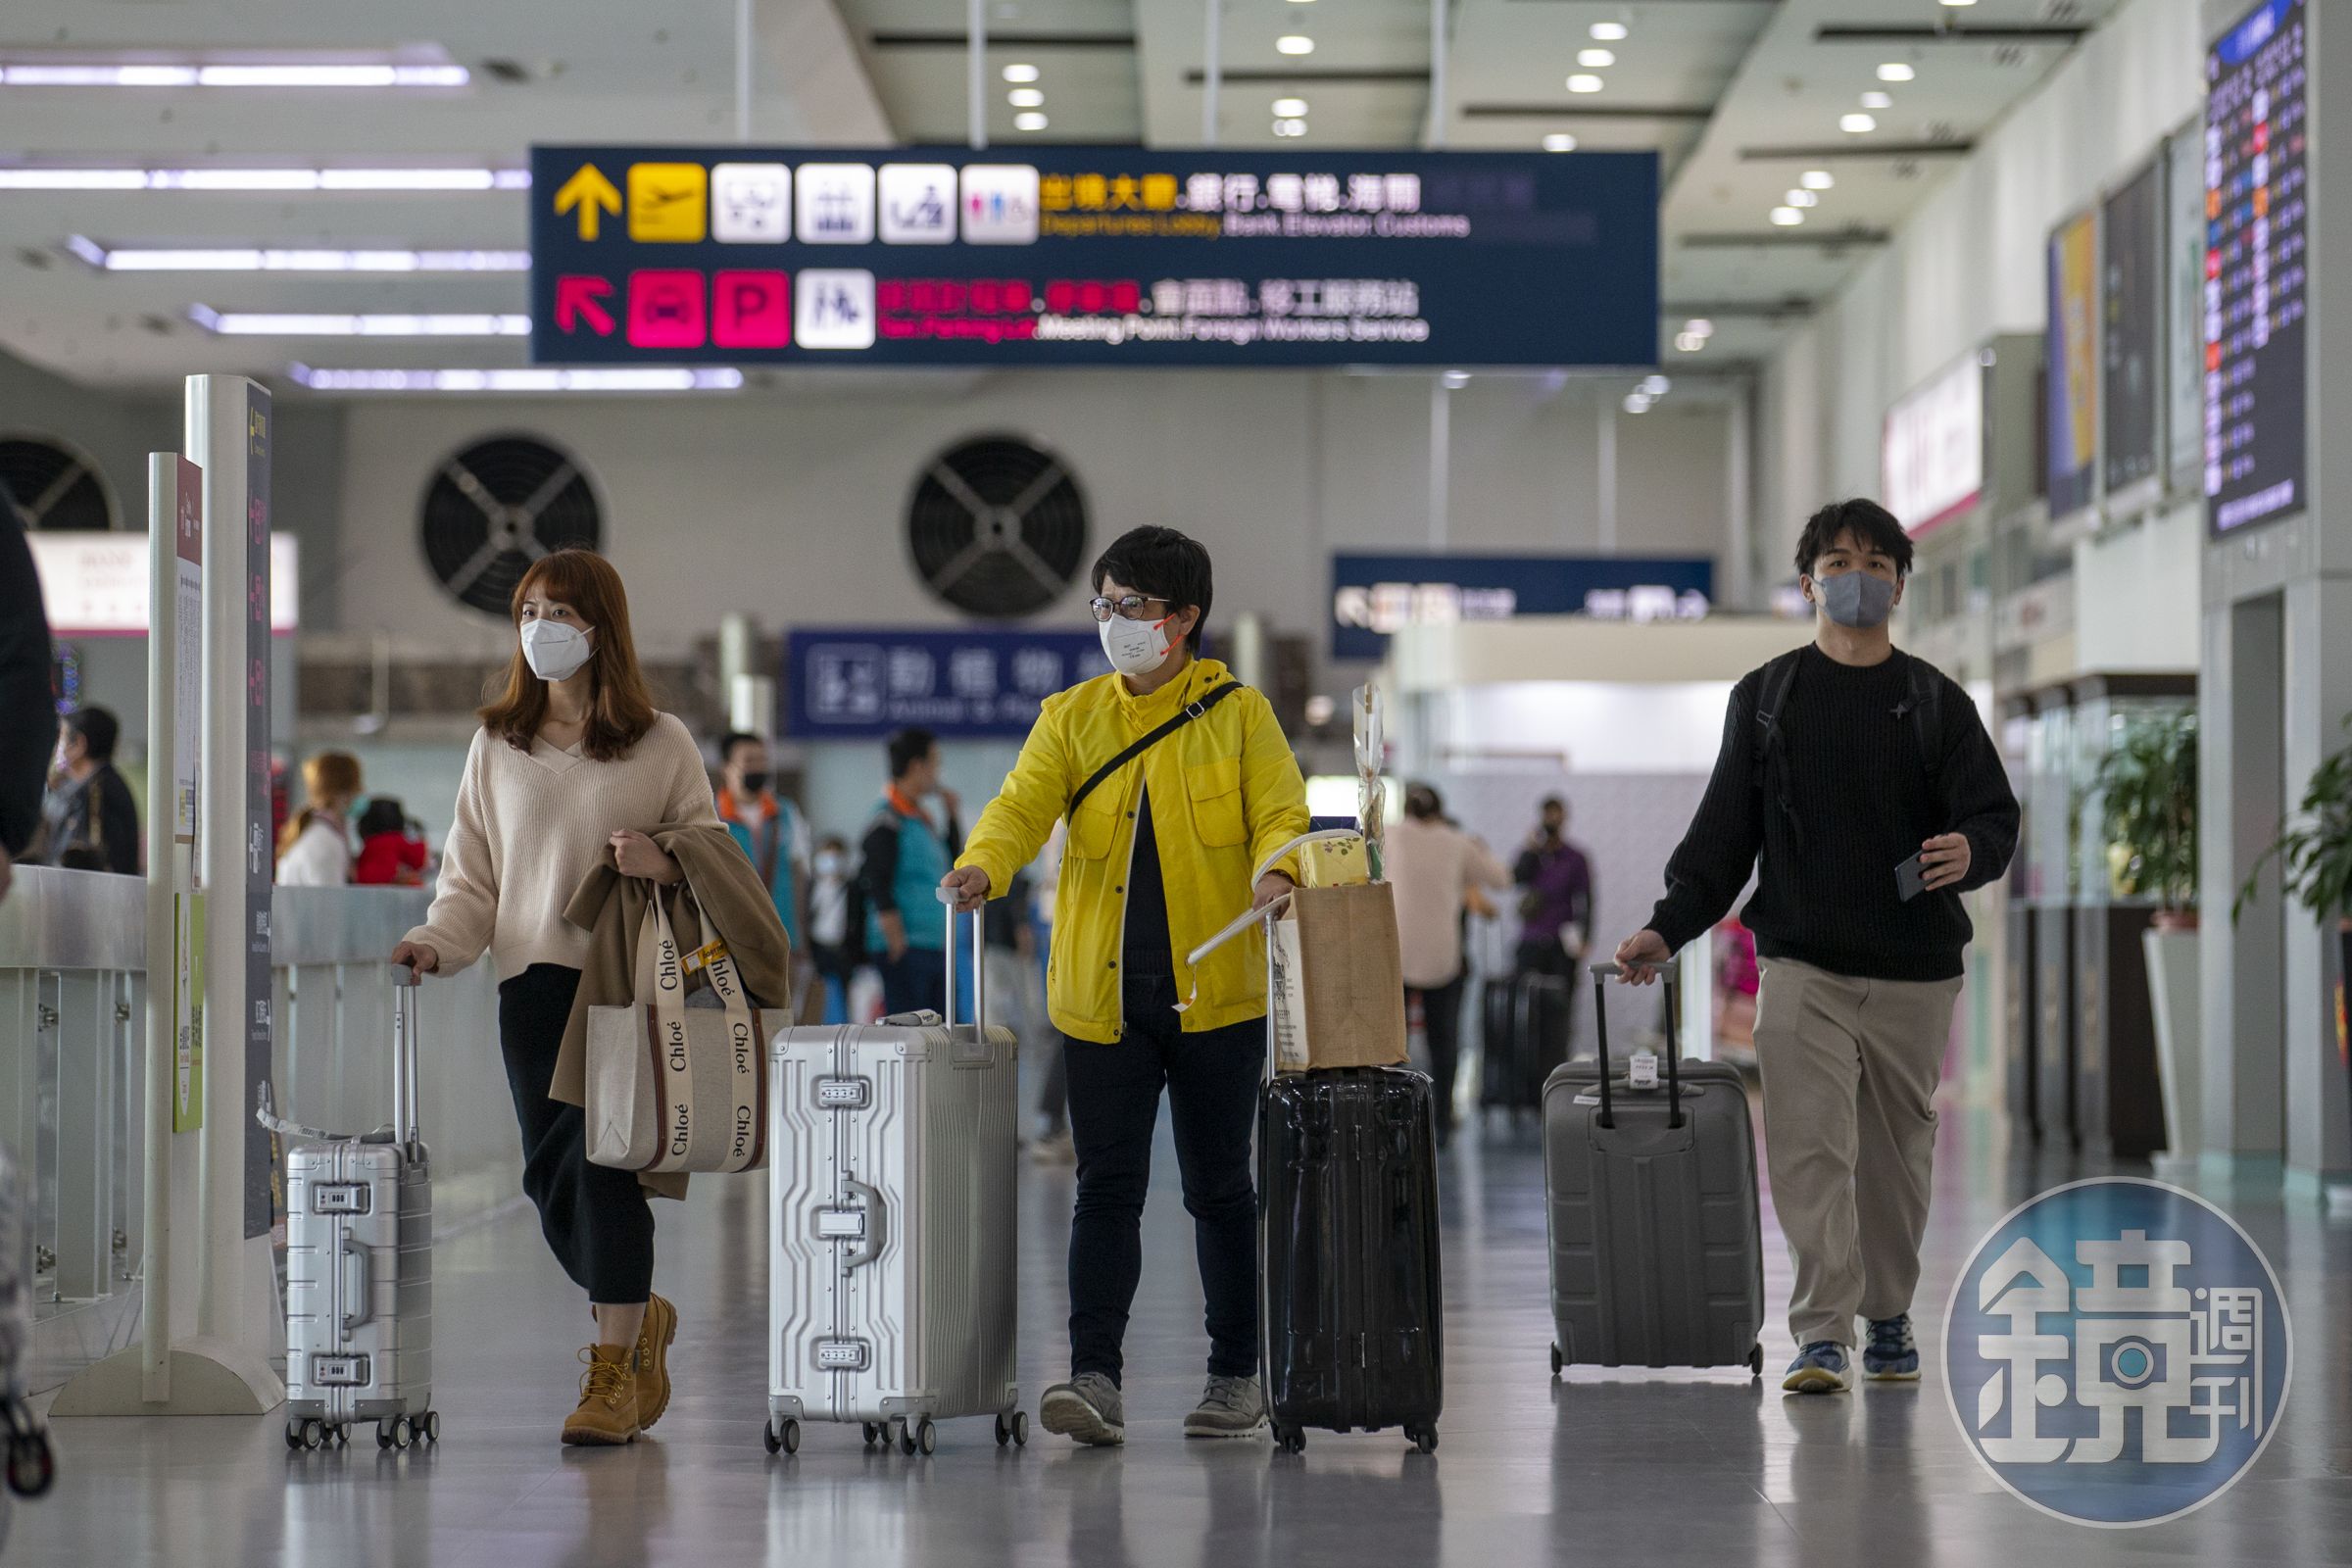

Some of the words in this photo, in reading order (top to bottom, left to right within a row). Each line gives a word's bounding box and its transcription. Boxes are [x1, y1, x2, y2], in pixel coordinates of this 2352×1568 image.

[659, 939, 678, 991] Chloé
[711, 956, 736, 998] hloé
[667, 1020, 686, 1072] Chloé
[733, 1022, 751, 1074] Chloé
[671, 1103, 689, 1157] Chloé
[733, 1104, 752, 1158] Chloé
